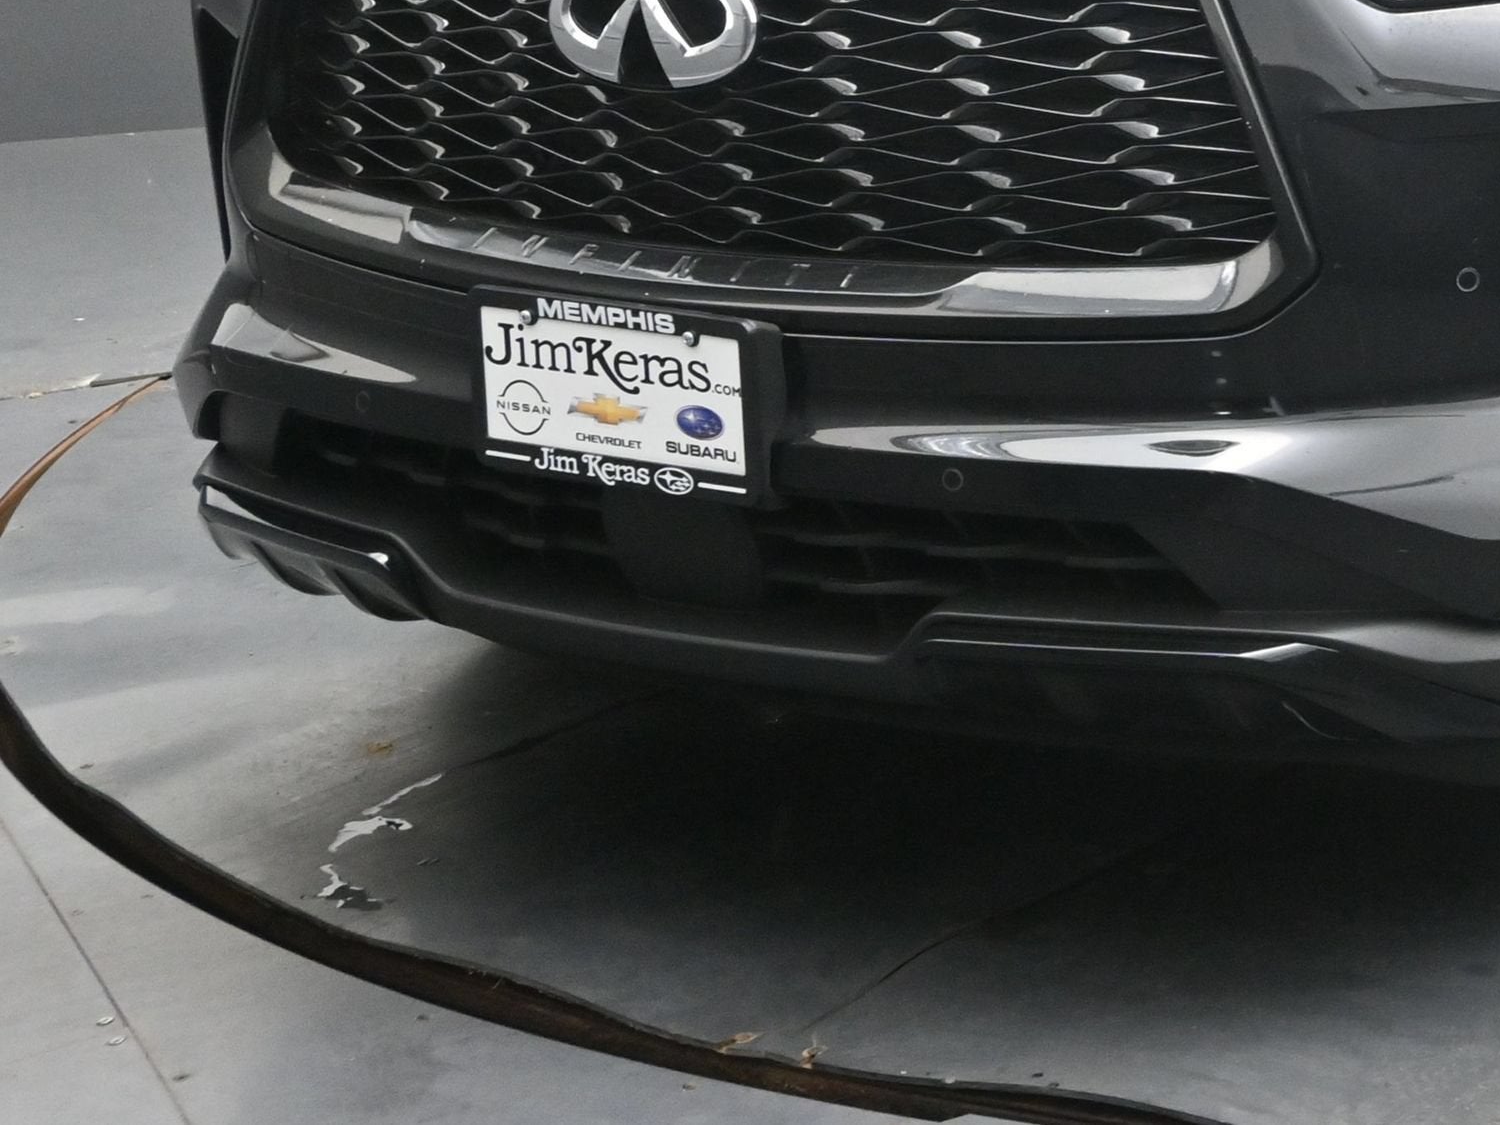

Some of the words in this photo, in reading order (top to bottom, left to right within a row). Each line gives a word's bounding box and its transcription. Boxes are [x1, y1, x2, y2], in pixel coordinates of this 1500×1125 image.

[472, 227, 859, 288] INFINITI
[537, 298, 676, 334] MEMPHIS
[496, 399, 551, 415] NISSAN
[576, 432, 642, 450] CHEVROLET
[665, 441, 737, 463] SUBARU
[534, 447, 580, 475] Jim
[581, 454, 650, 486] Keras
